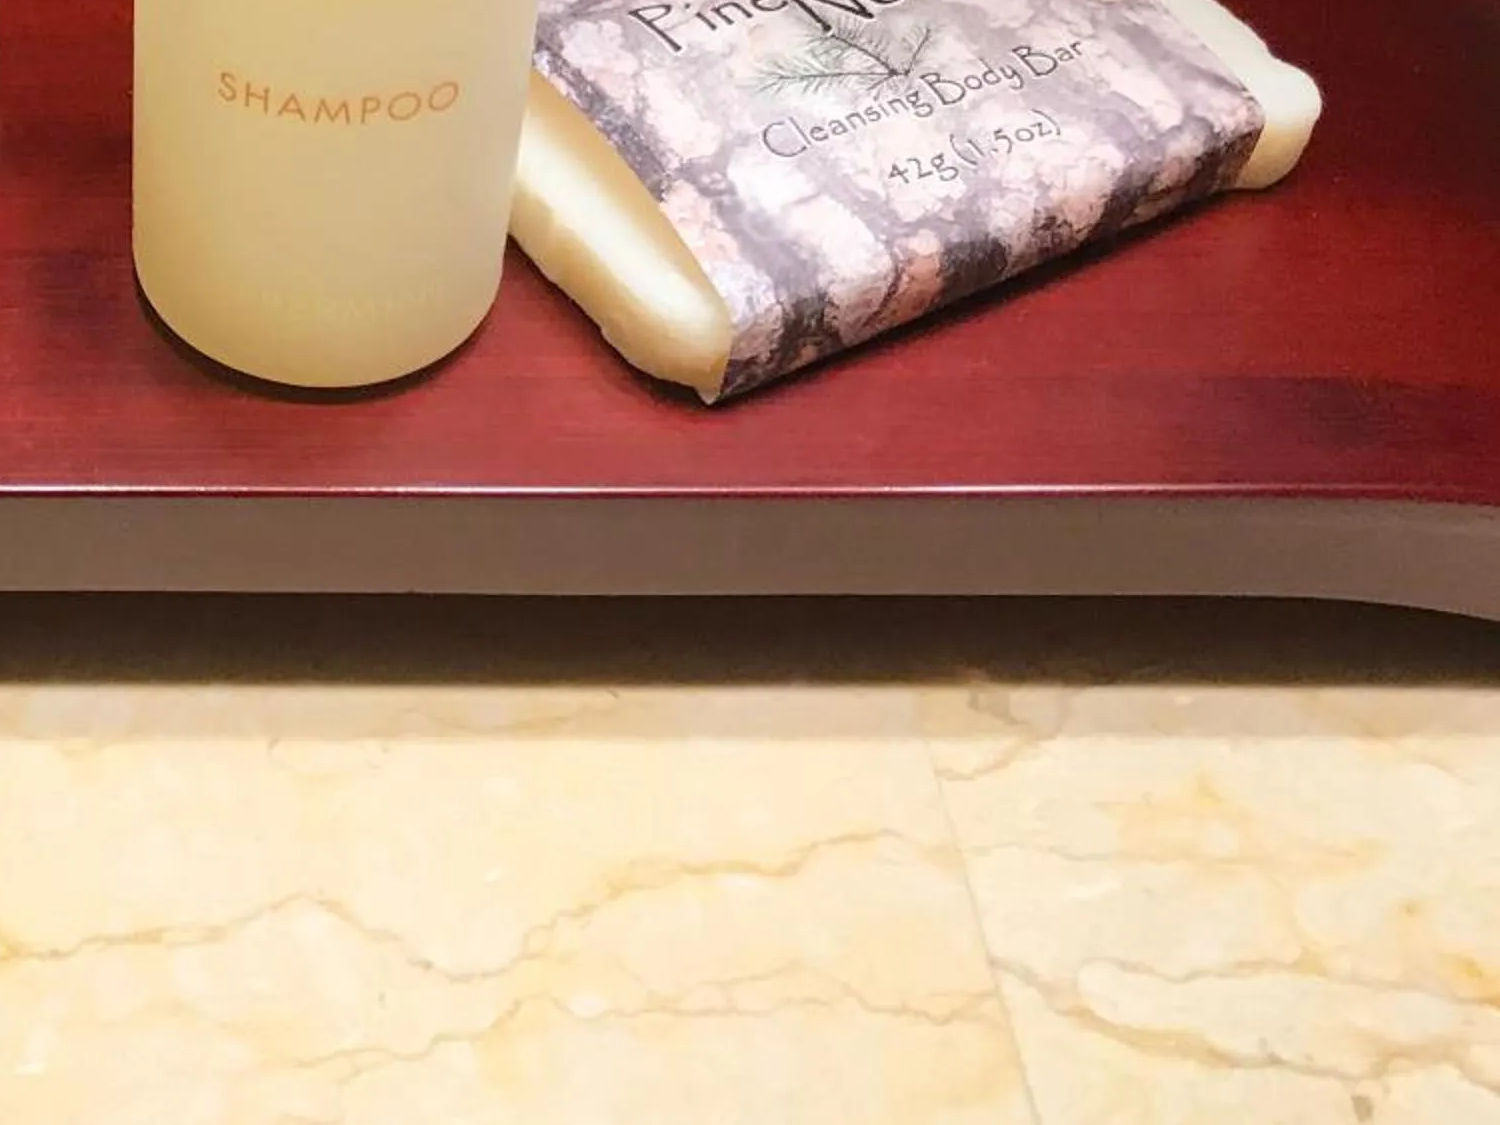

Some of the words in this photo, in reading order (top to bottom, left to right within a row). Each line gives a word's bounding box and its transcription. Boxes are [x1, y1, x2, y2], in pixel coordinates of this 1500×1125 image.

[217, 72, 459, 125] SHAMPOO
[762, 90, 934, 158] Cleansing
[920, 58, 1024, 106] Body
[1012, 40, 1083, 77] Bar
